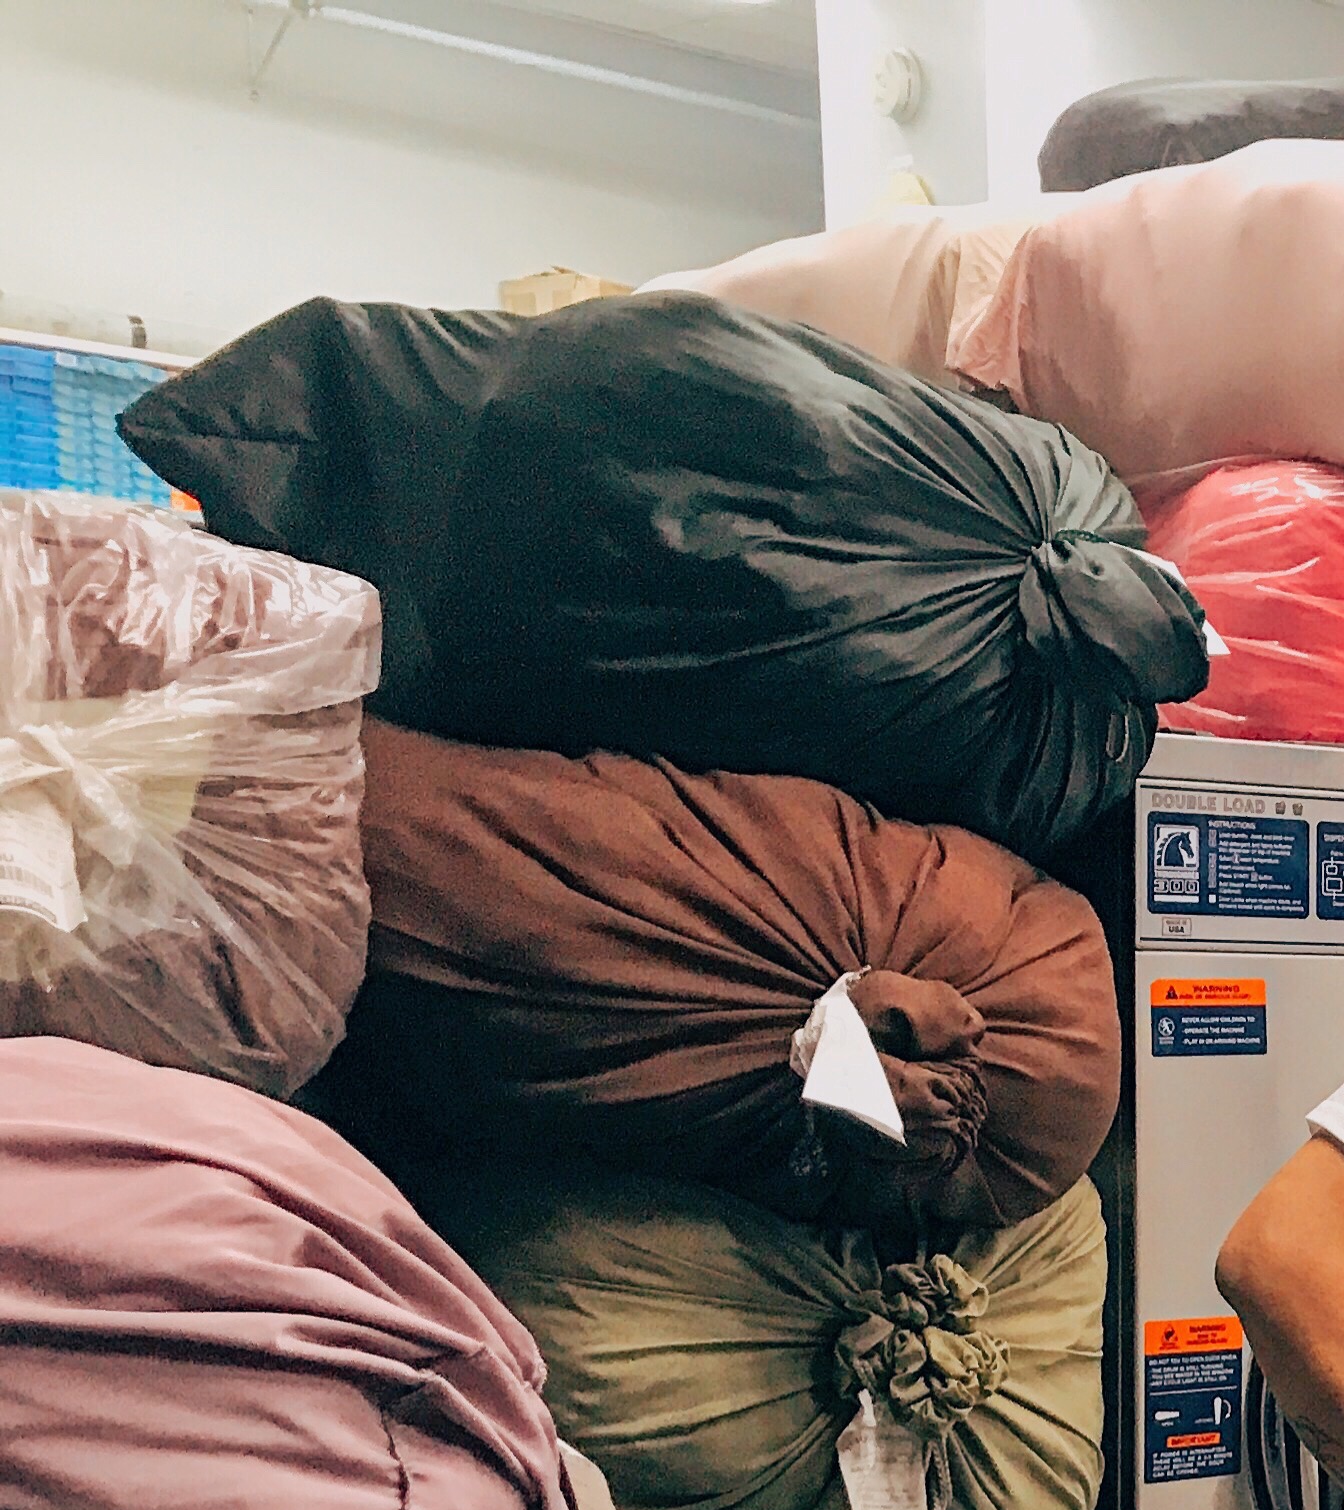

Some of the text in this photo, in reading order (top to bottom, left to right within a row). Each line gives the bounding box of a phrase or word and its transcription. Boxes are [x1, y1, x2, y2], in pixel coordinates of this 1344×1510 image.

[1152, 793, 1266, 814] DOUBLE LOAD
[1168, 926, 1185, 934] USA
